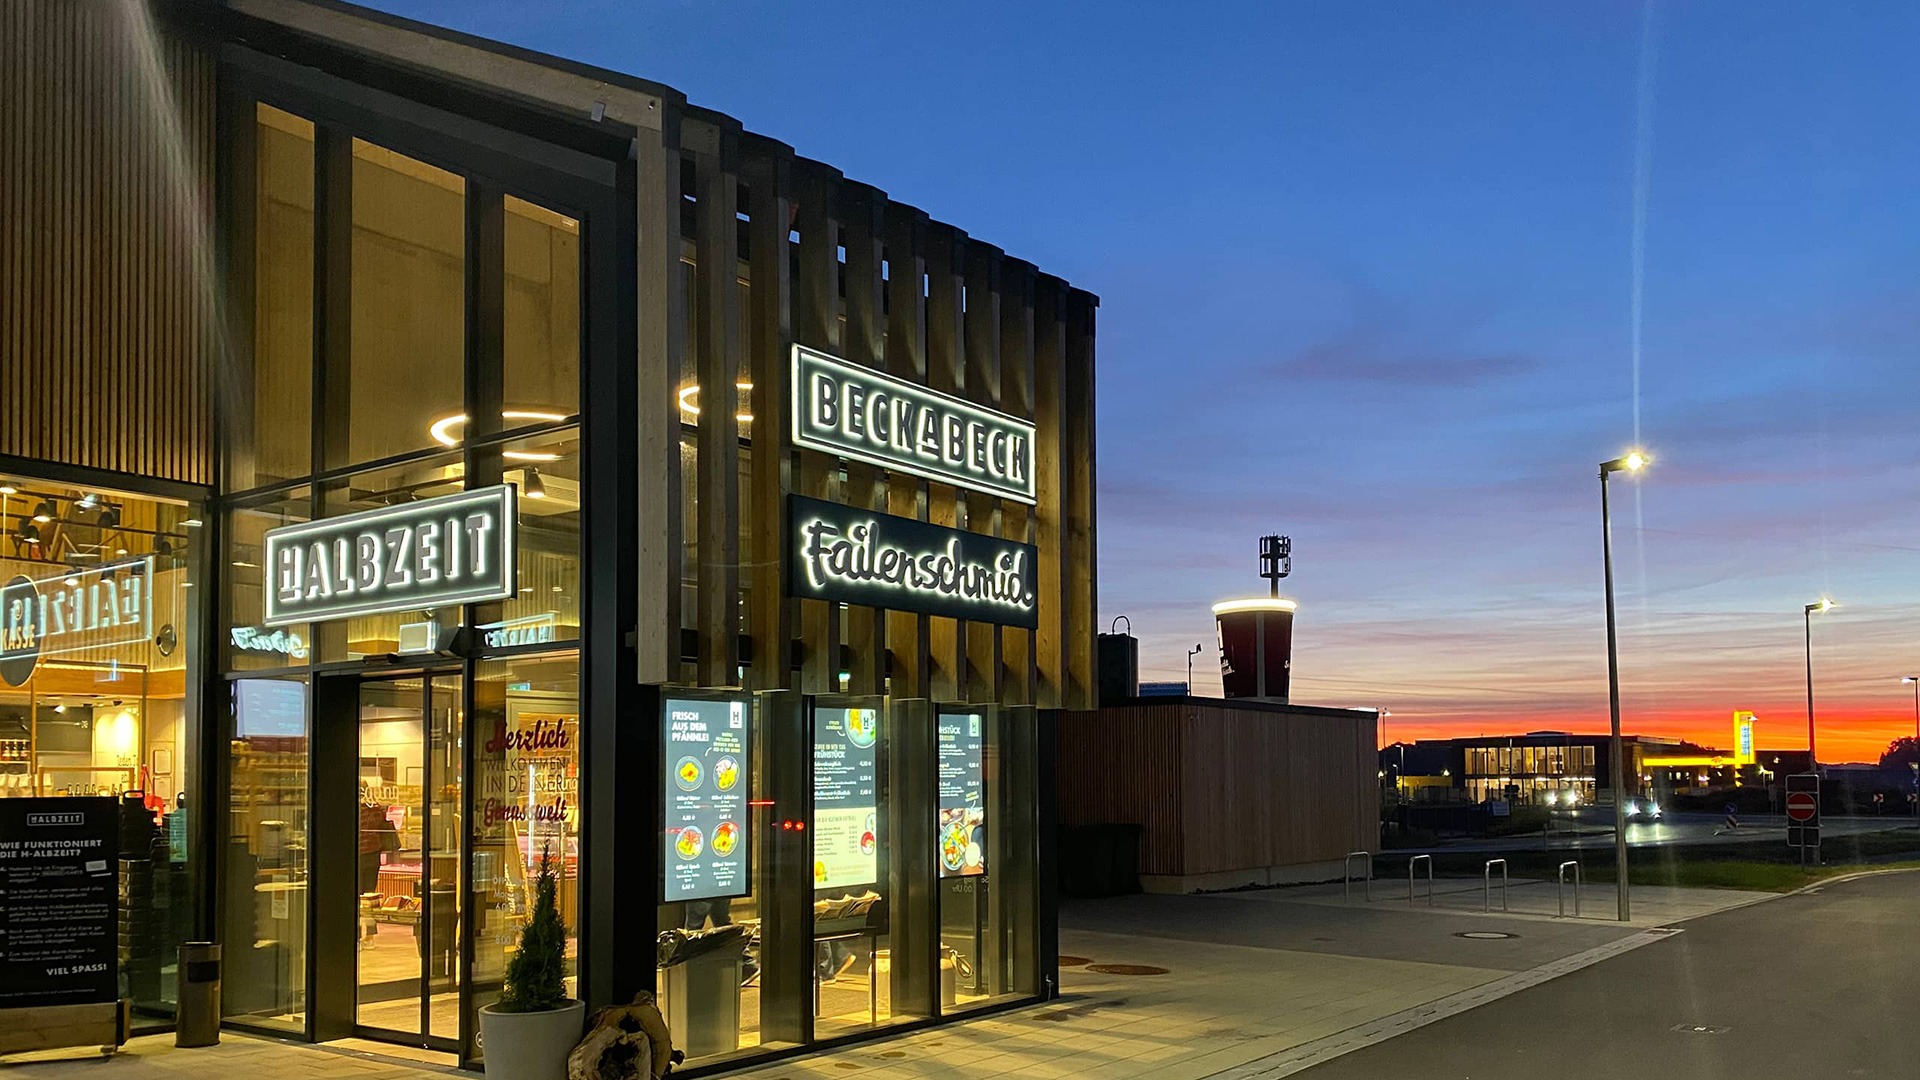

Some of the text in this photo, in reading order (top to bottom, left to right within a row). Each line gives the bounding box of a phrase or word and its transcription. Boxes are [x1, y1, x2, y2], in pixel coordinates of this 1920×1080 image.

[814, 373, 1026, 482] BECKABECK
[277, 513, 489, 602] HALBZEIT
[803, 519, 1034, 609] Failenschmid
[1, 625, 35, 650] KASSE
[672, 711, 699, 721] FRISCH
[672, 722, 707, 732] AUS DEM
[939, 725, 961, 734] HSTÜCK
[485, 718, 569, 753] Herzlich
[672, 731, 709, 742] PFÄNNLE!
[485, 757, 567, 771] WILLKOMMEN
[486, 776, 502, 792] IN
[31, 815, 80, 823] HALBZEIT
[24, 840, 102, 849] FUNKTIONIERT
[21, 849, 81, 857] H-ALBZEIT?
[46, 963, 107, 975] VIEL SPASS!
